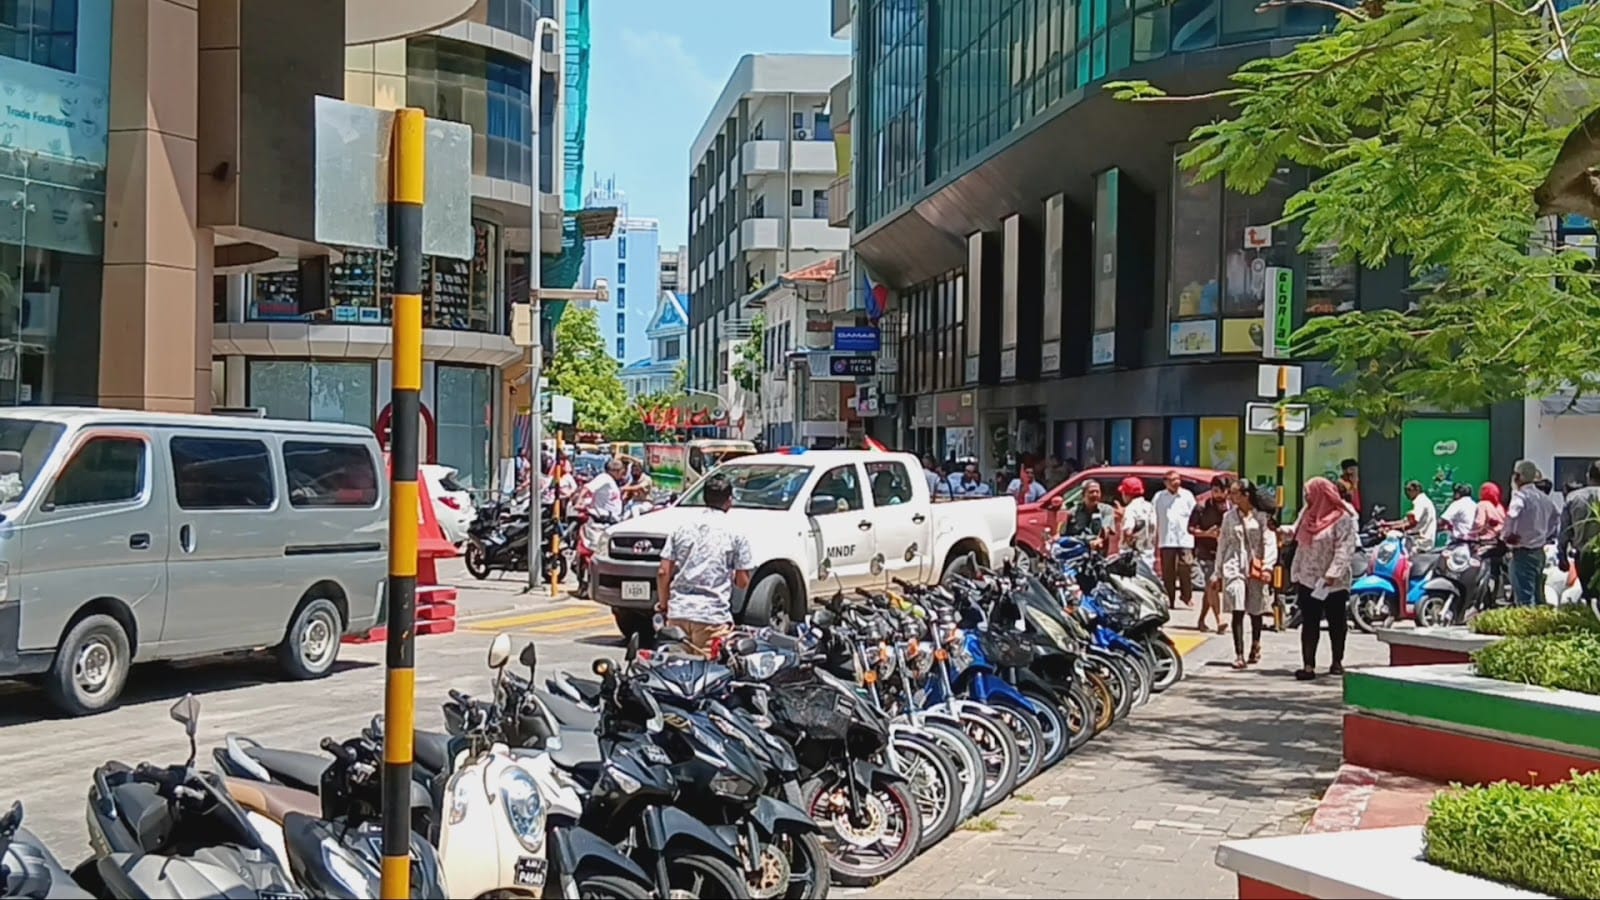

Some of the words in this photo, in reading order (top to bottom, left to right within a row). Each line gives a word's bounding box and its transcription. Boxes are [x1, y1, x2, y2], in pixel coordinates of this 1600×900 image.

[6, 105, 31, 119] Trade
[849, 364, 873, 373] TECH
[827, 544, 856, 558] MNDF
